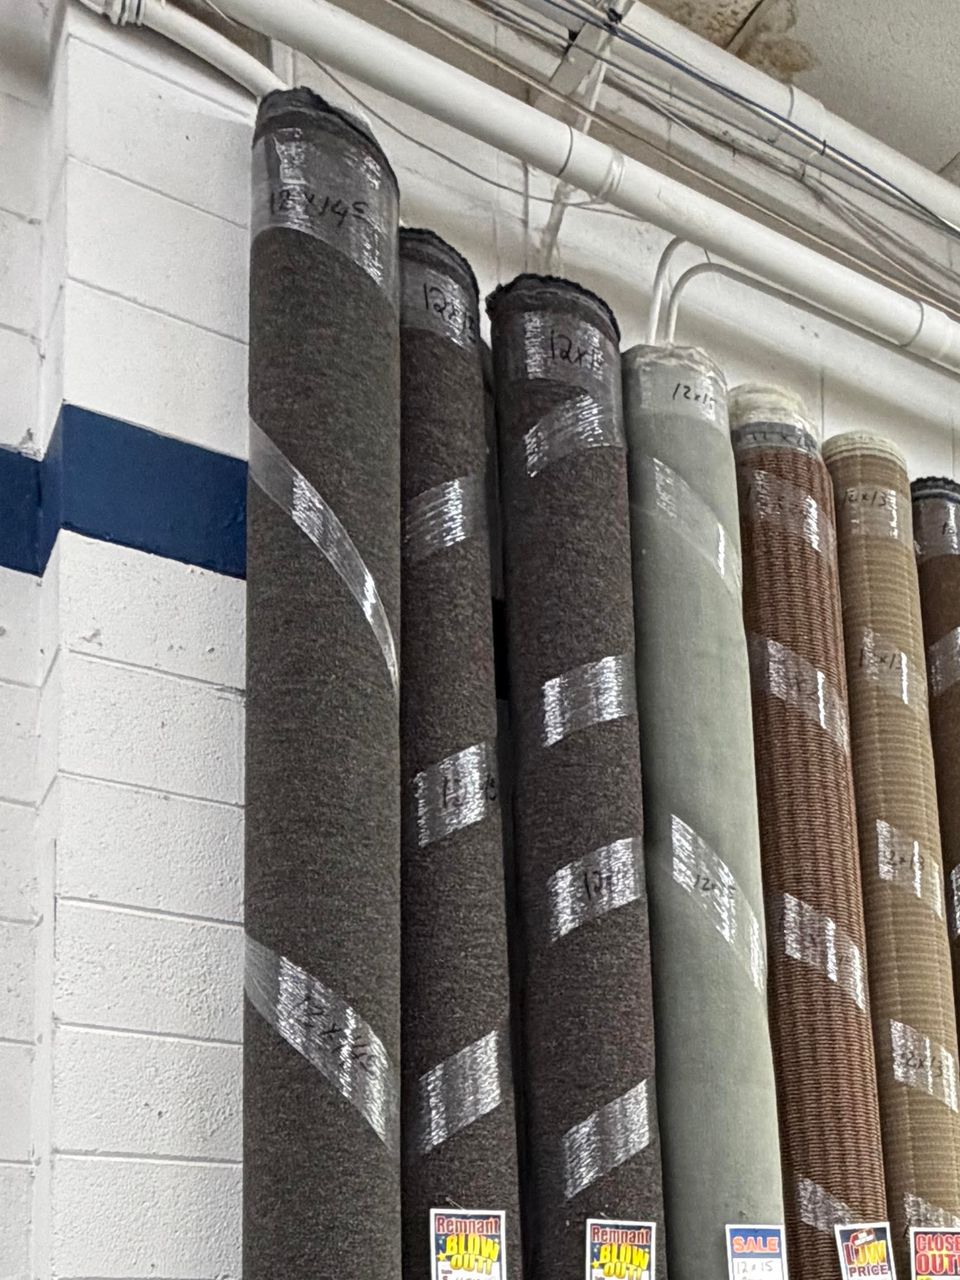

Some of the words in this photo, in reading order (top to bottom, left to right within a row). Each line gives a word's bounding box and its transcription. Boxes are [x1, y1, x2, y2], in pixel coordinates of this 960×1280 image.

[436, 1215, 500, 1235] Remnant
[591, 1226, 651, 1245] Remnant
[732, 1236, 780, 1253] SALE
[445, 1232, 500, 1262] BLOW
[599, 1242, 649, 1271] BLOW
[450, 1253, 493, 1275] OUT!
[849, 1264, 889, 1278] PRICE
